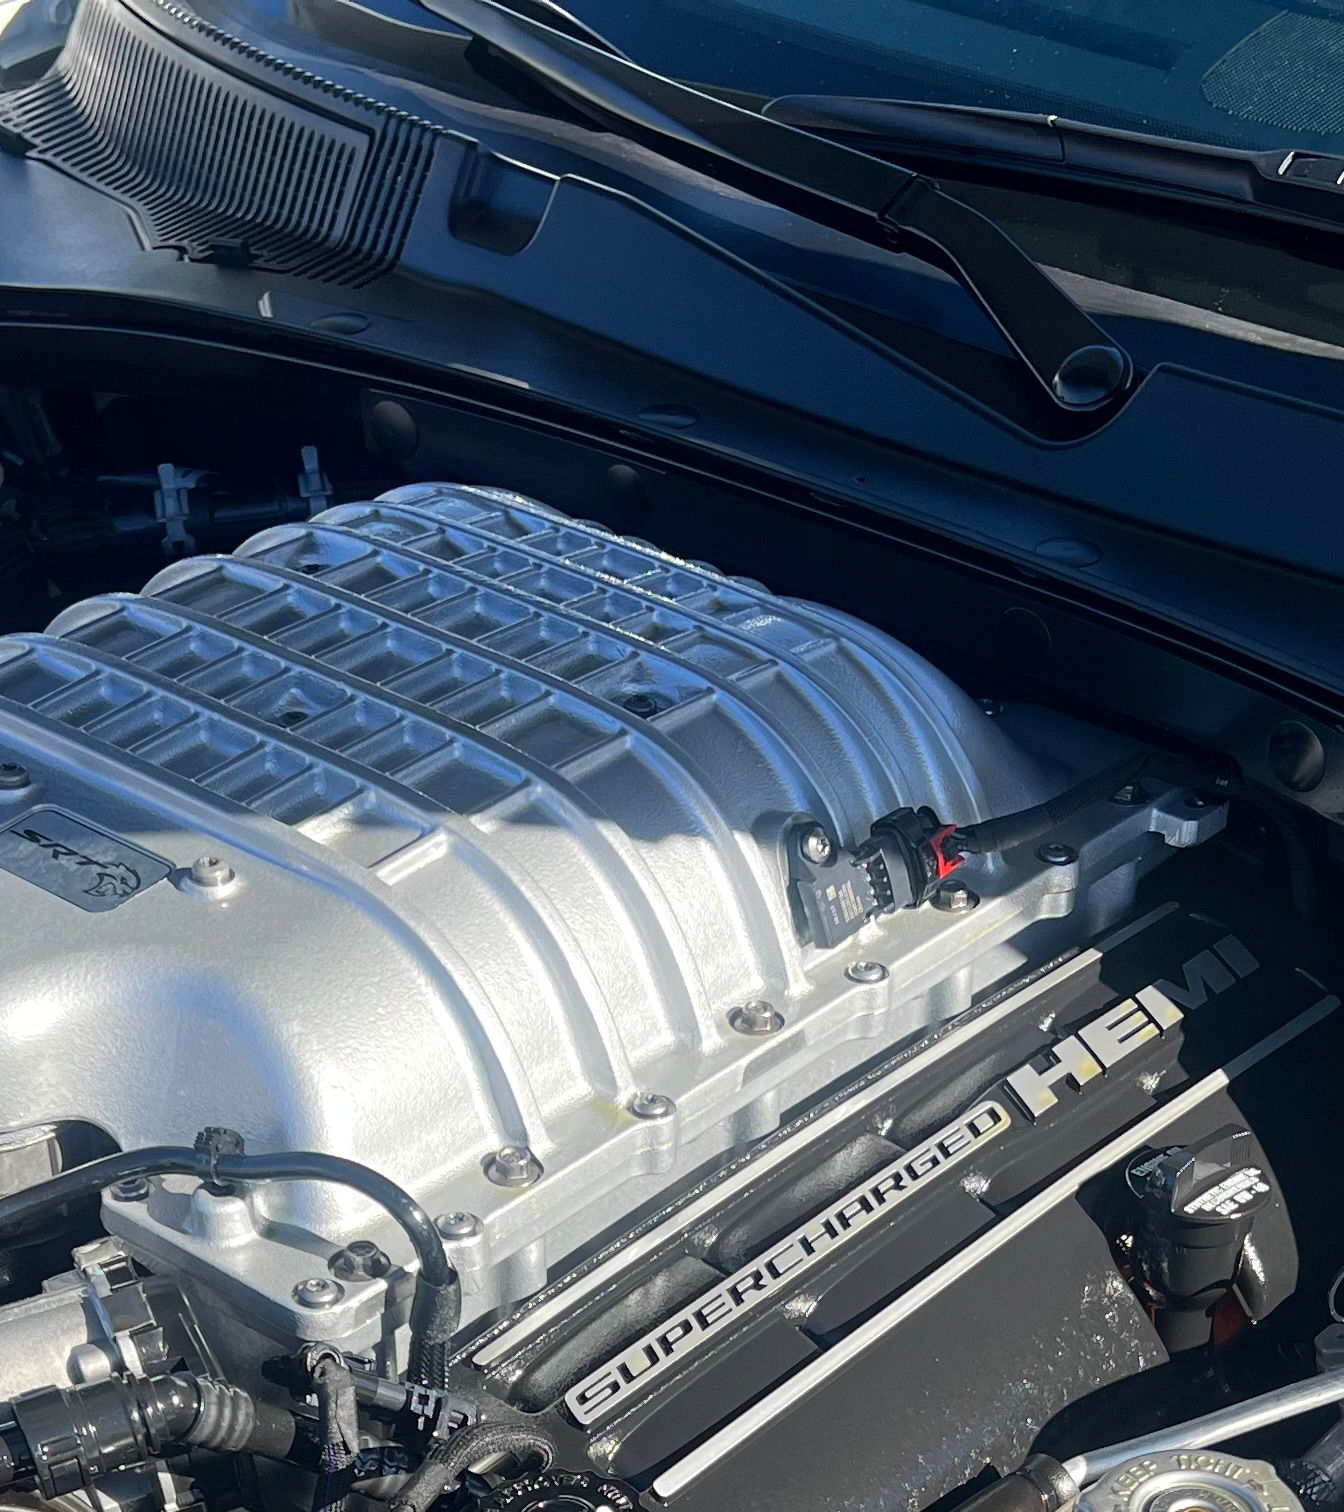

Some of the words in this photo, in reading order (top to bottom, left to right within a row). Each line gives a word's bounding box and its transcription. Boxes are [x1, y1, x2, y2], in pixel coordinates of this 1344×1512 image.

[9, 828, 110, 869] SRT
[572, 1103, 1005, 1412] SUPERCHARGED
[1006, 934, 1260, 1119] HEMI
[1112, 1459, 1158, 1501] KEEP
[1172, 1453, 1249, 1480] TIGHT
